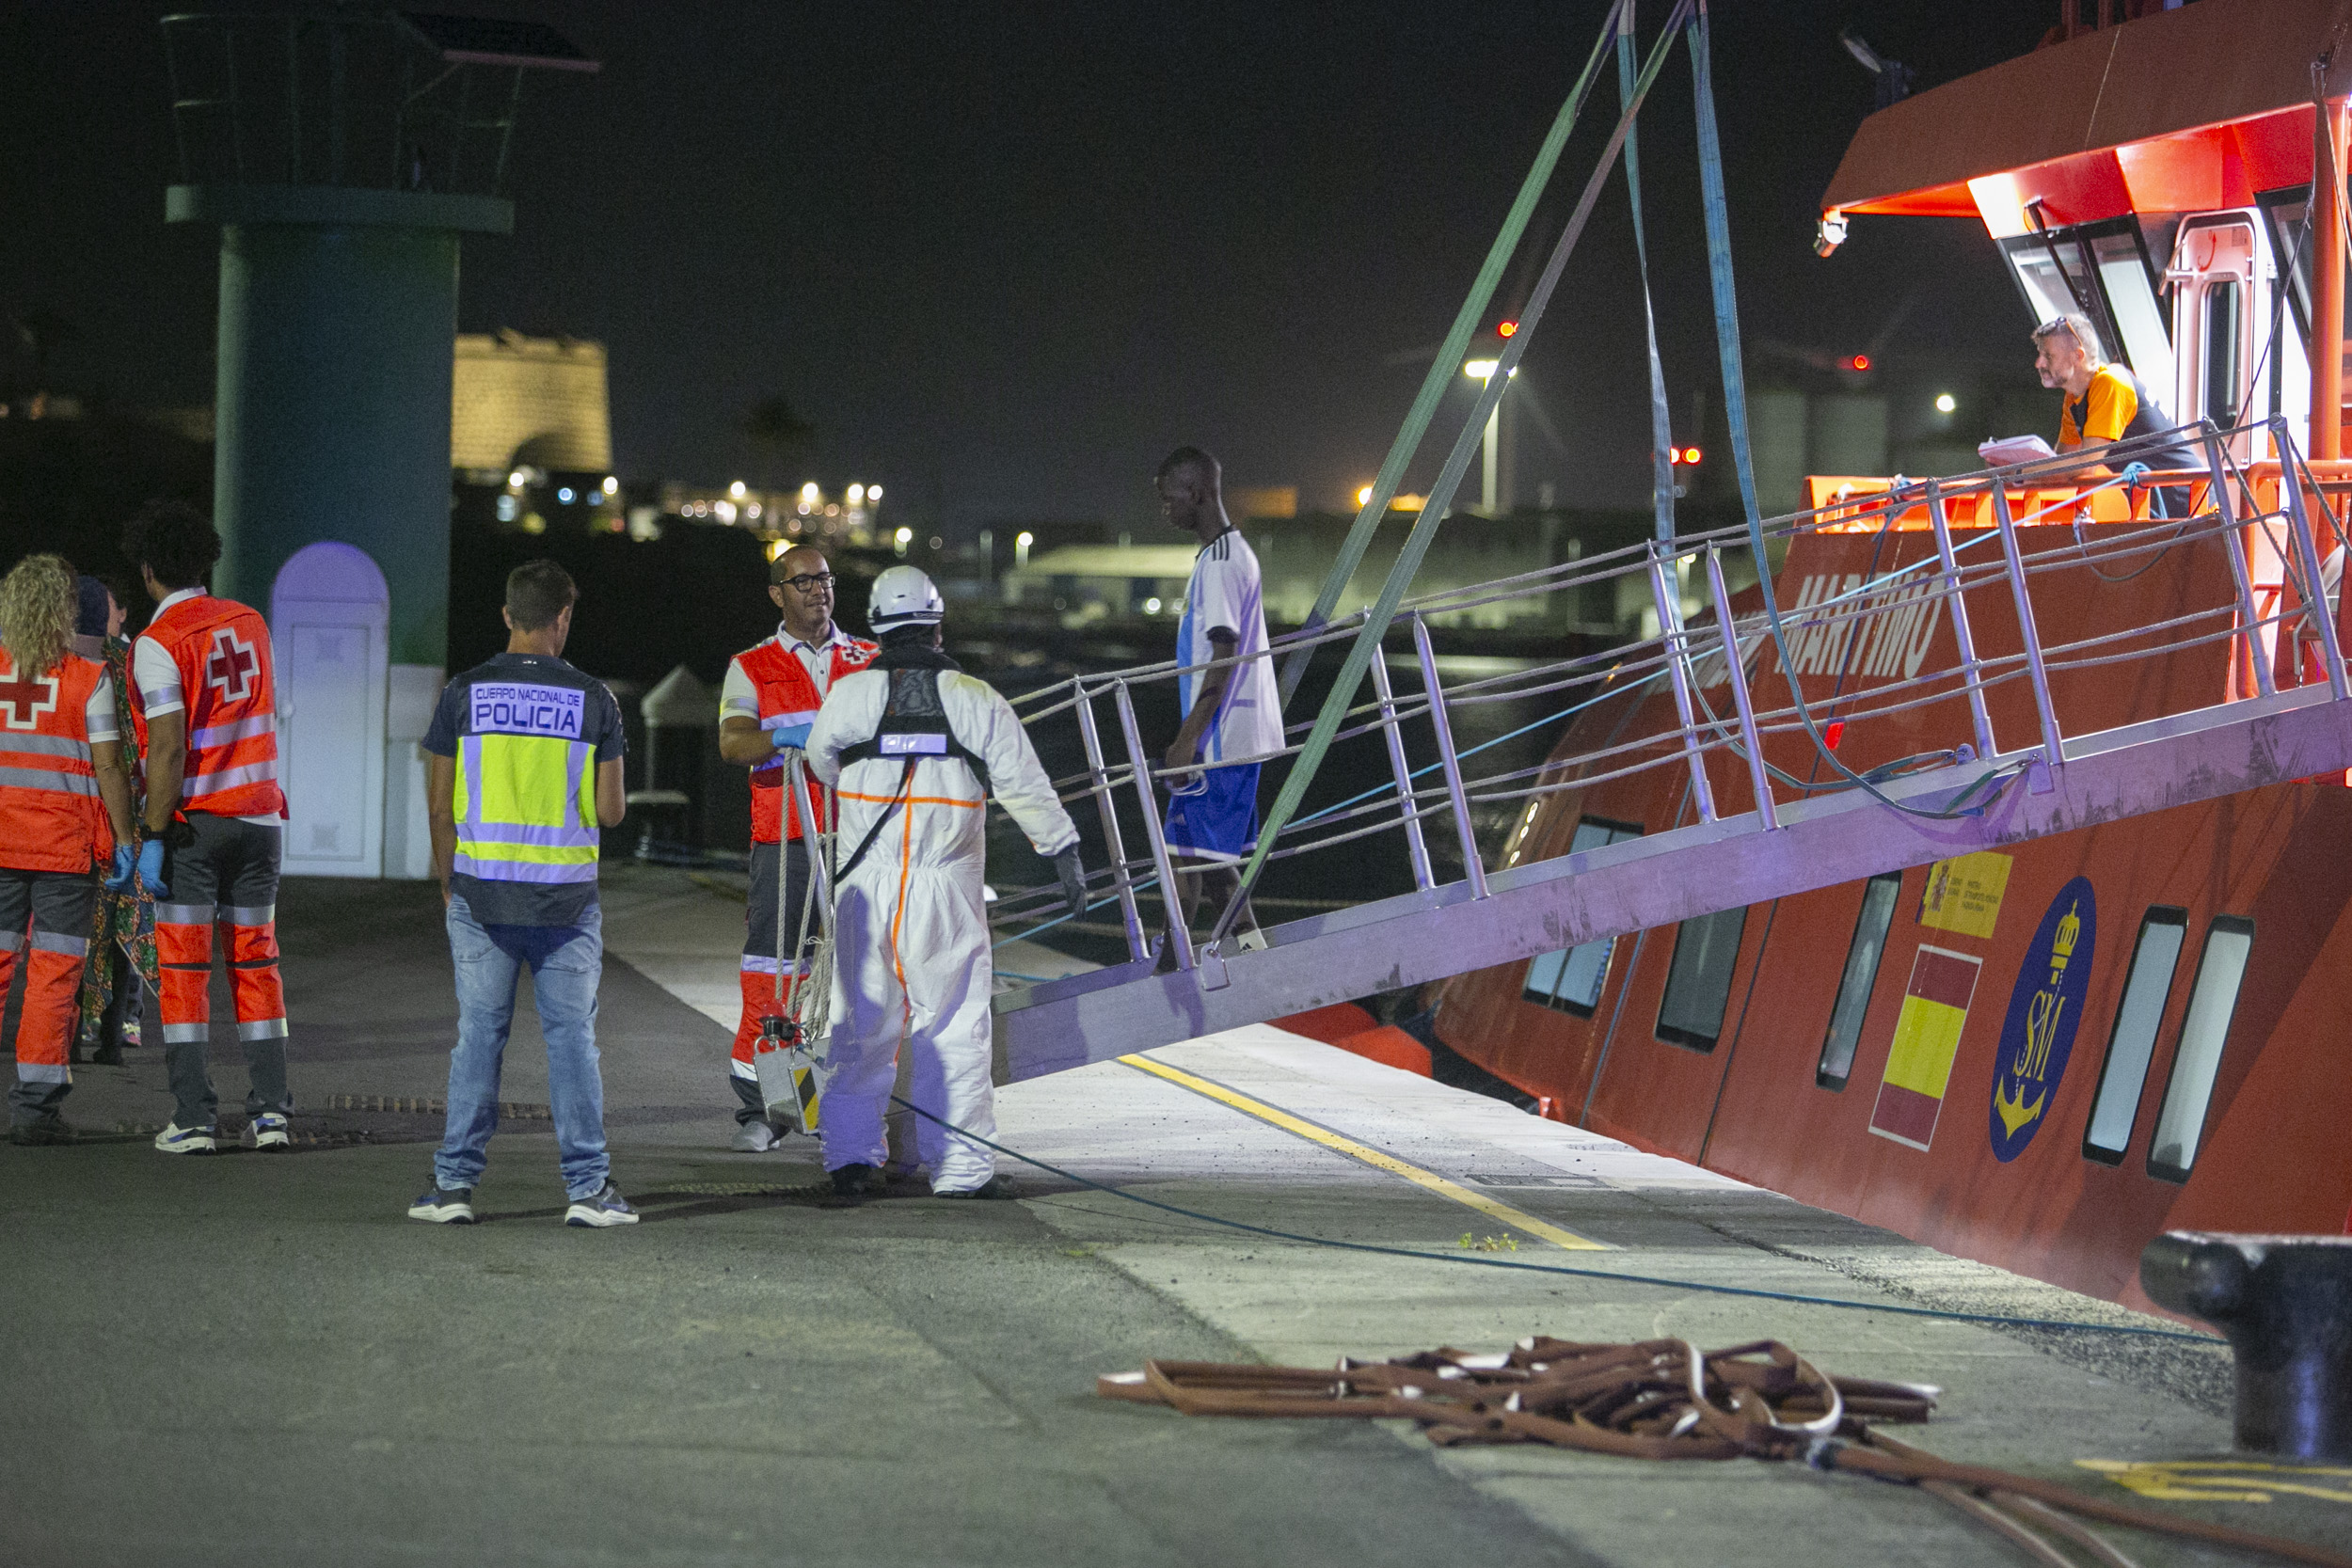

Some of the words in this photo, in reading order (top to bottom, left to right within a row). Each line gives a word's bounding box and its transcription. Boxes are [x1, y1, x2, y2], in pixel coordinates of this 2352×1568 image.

[476, 688, 516, 700] CUERPO
[517, 689, 564, 704] NACIONAL
[566, 694, 580, 707] DE
[476, 704, 576, 733] POLICIA
[2012, 990, 2066, 1082] SM
